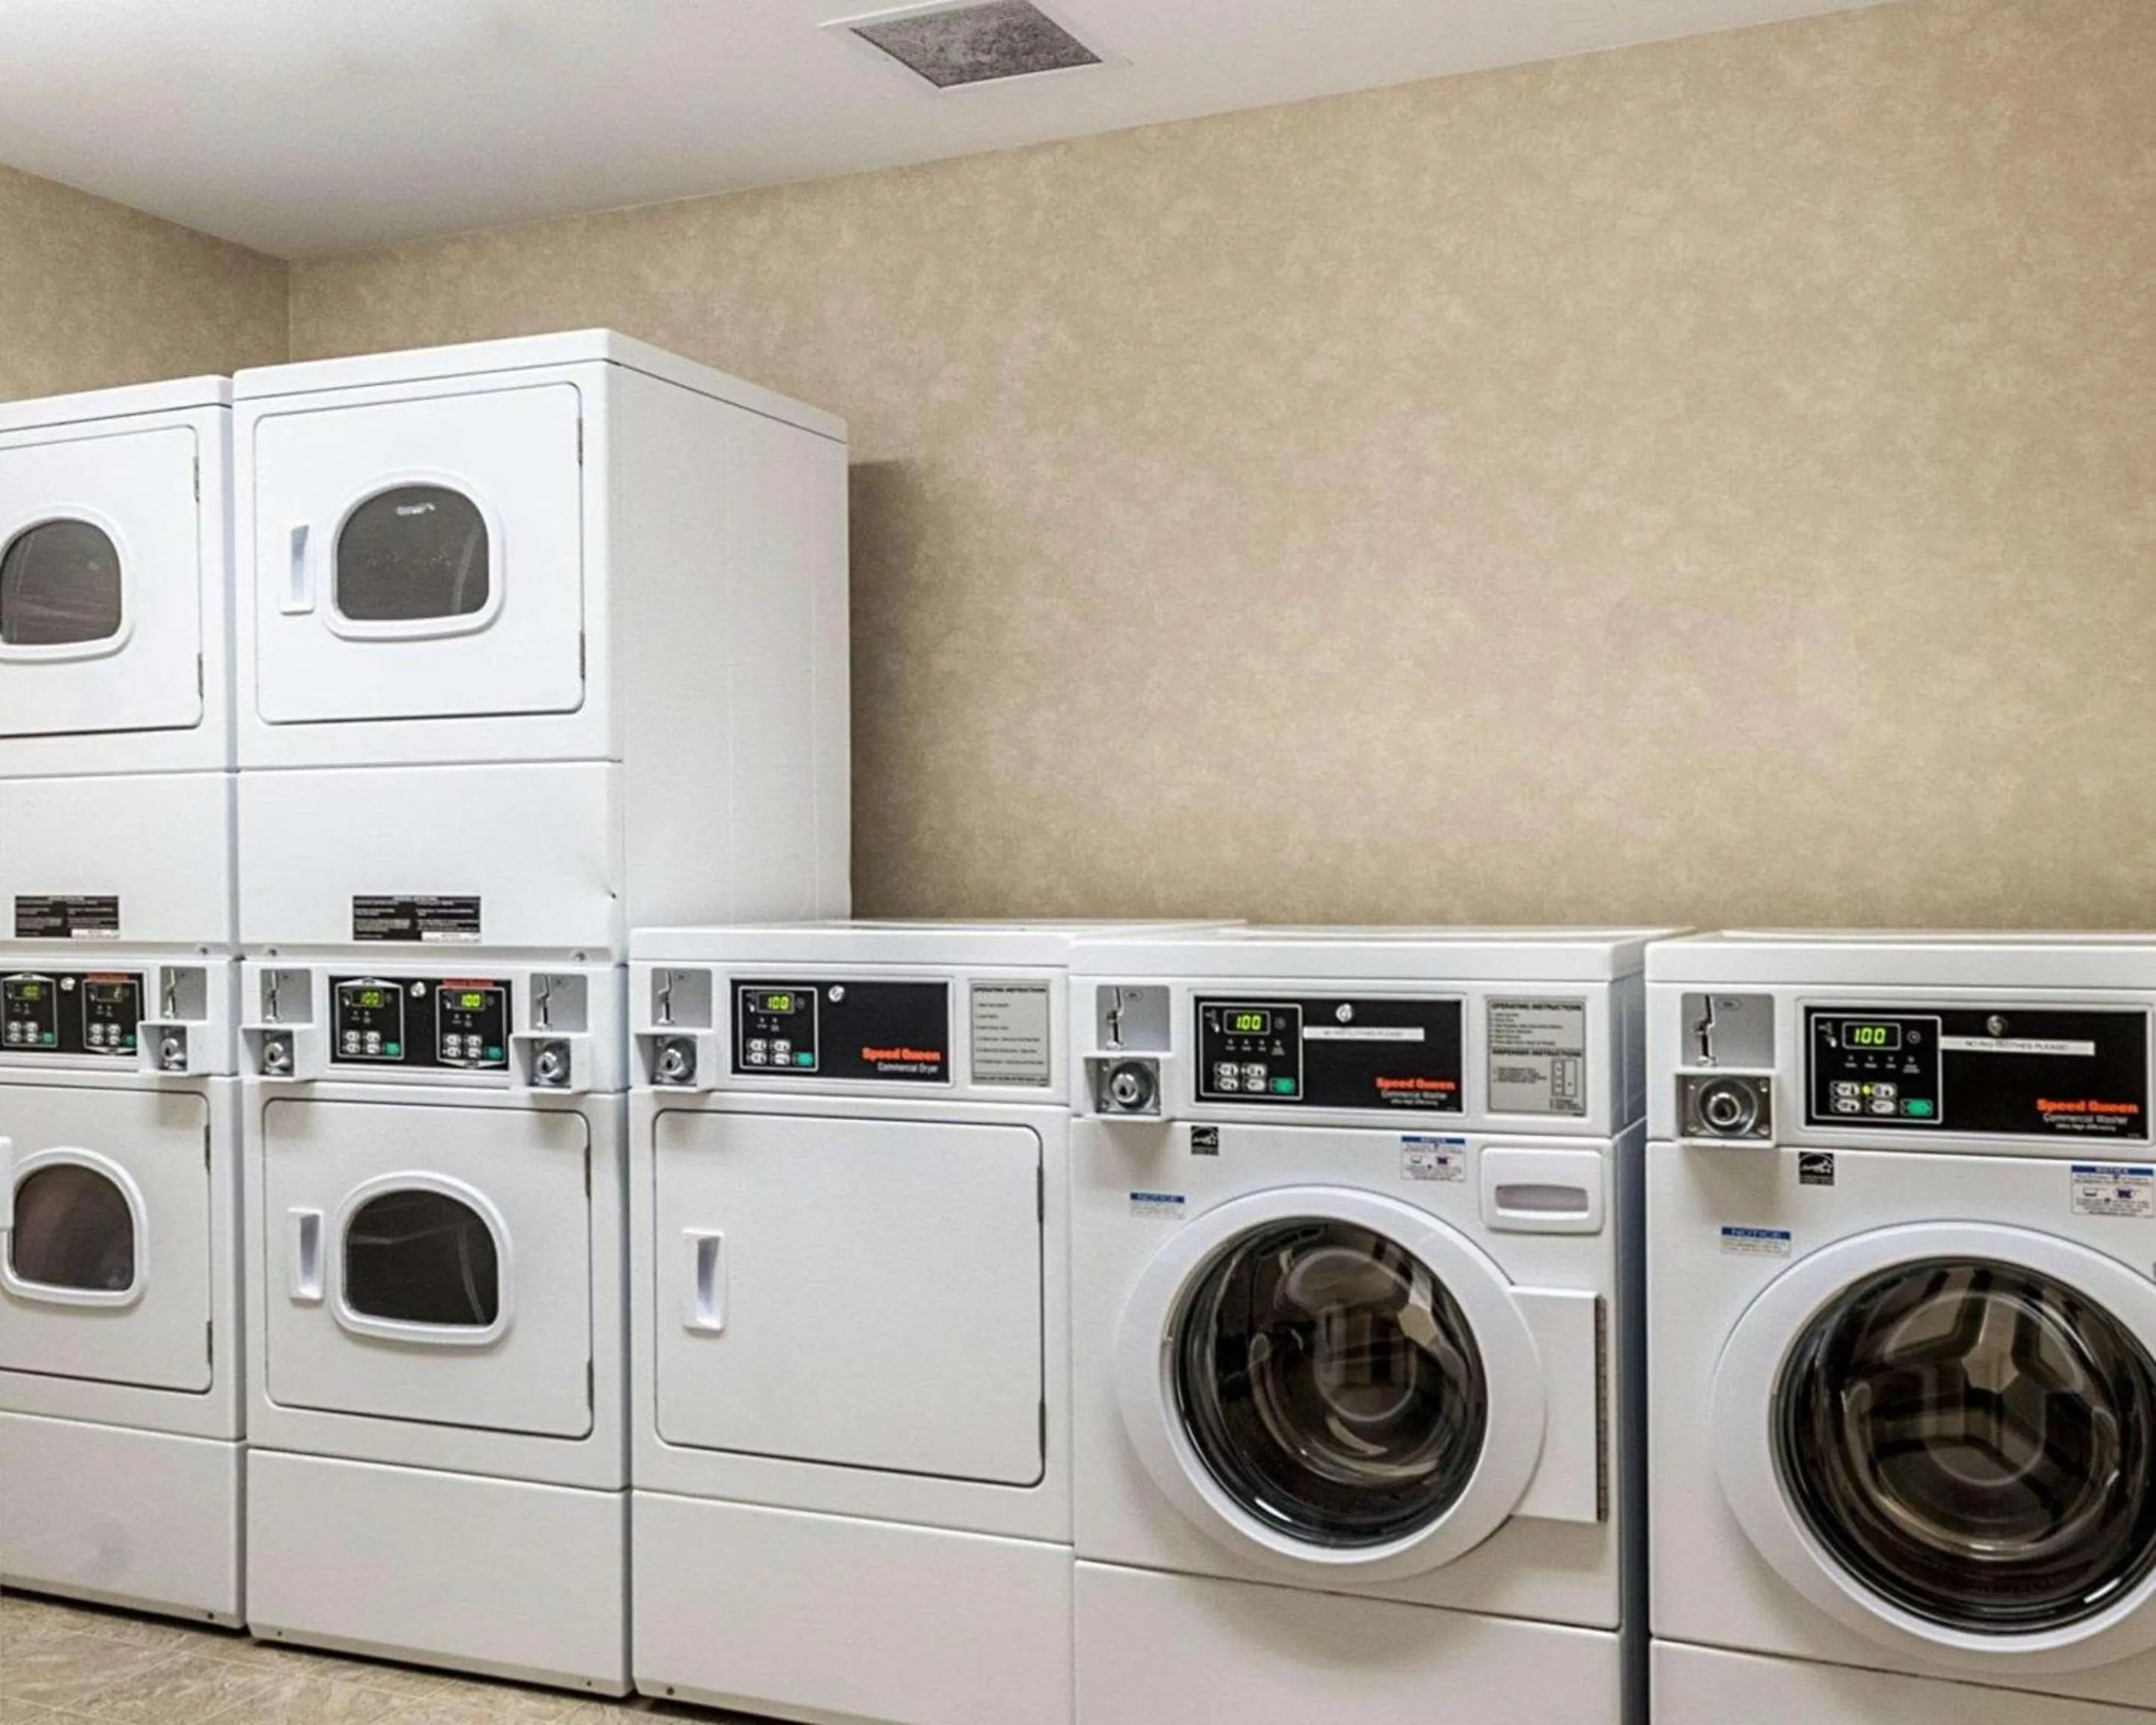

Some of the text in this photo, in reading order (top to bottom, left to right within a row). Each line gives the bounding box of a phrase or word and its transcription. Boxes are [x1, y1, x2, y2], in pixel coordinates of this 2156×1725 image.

[767, 996, 789, 1010] 100
[1237, 1014, 1261, 1030] 100
[1854, 1027, 1886, 1044] 100
[862, 1047, 941, 1062] Speed Queen
[877, 1062, 938, 1075] Commercial Dryer
[1376, 1077, 1456, 1090] Speed Queen
[2037, 1098, 2139, 1113] Speed Queen
